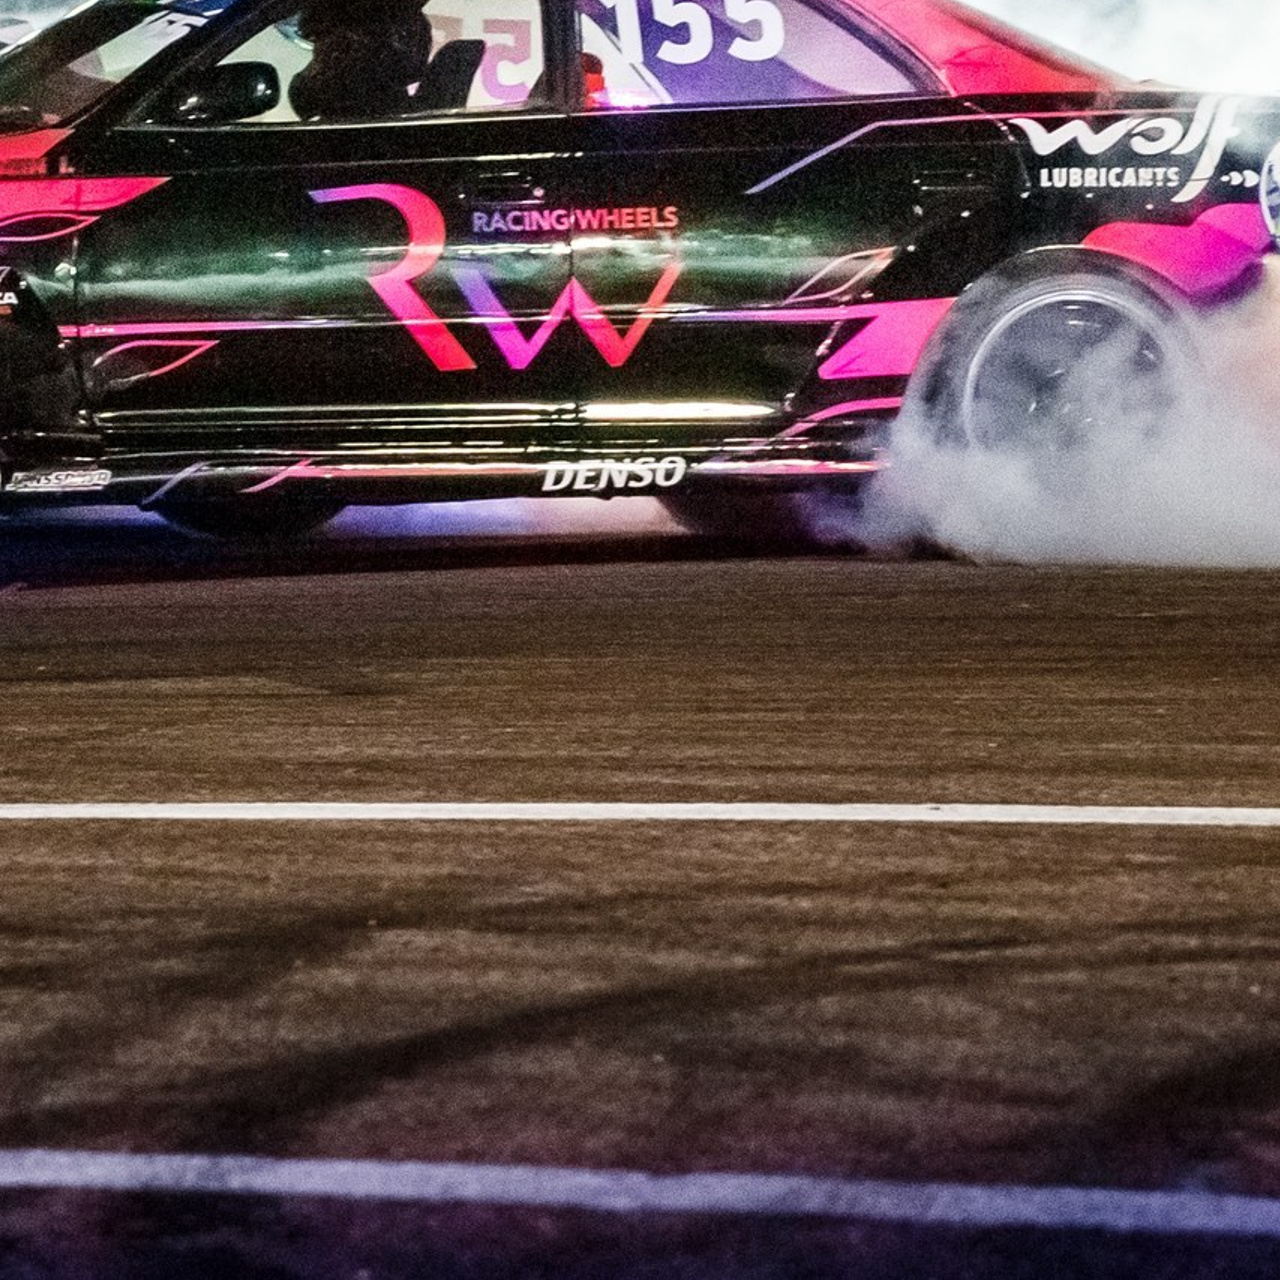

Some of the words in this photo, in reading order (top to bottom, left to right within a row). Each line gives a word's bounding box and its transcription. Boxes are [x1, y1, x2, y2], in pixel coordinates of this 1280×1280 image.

[1039, 167, 1180, 188] LUBRICANTS
[473, 210, 571, 232] RACING
[574, 207, 678, 230] WHEELS
[541, 456, 687, 491] DENSO
